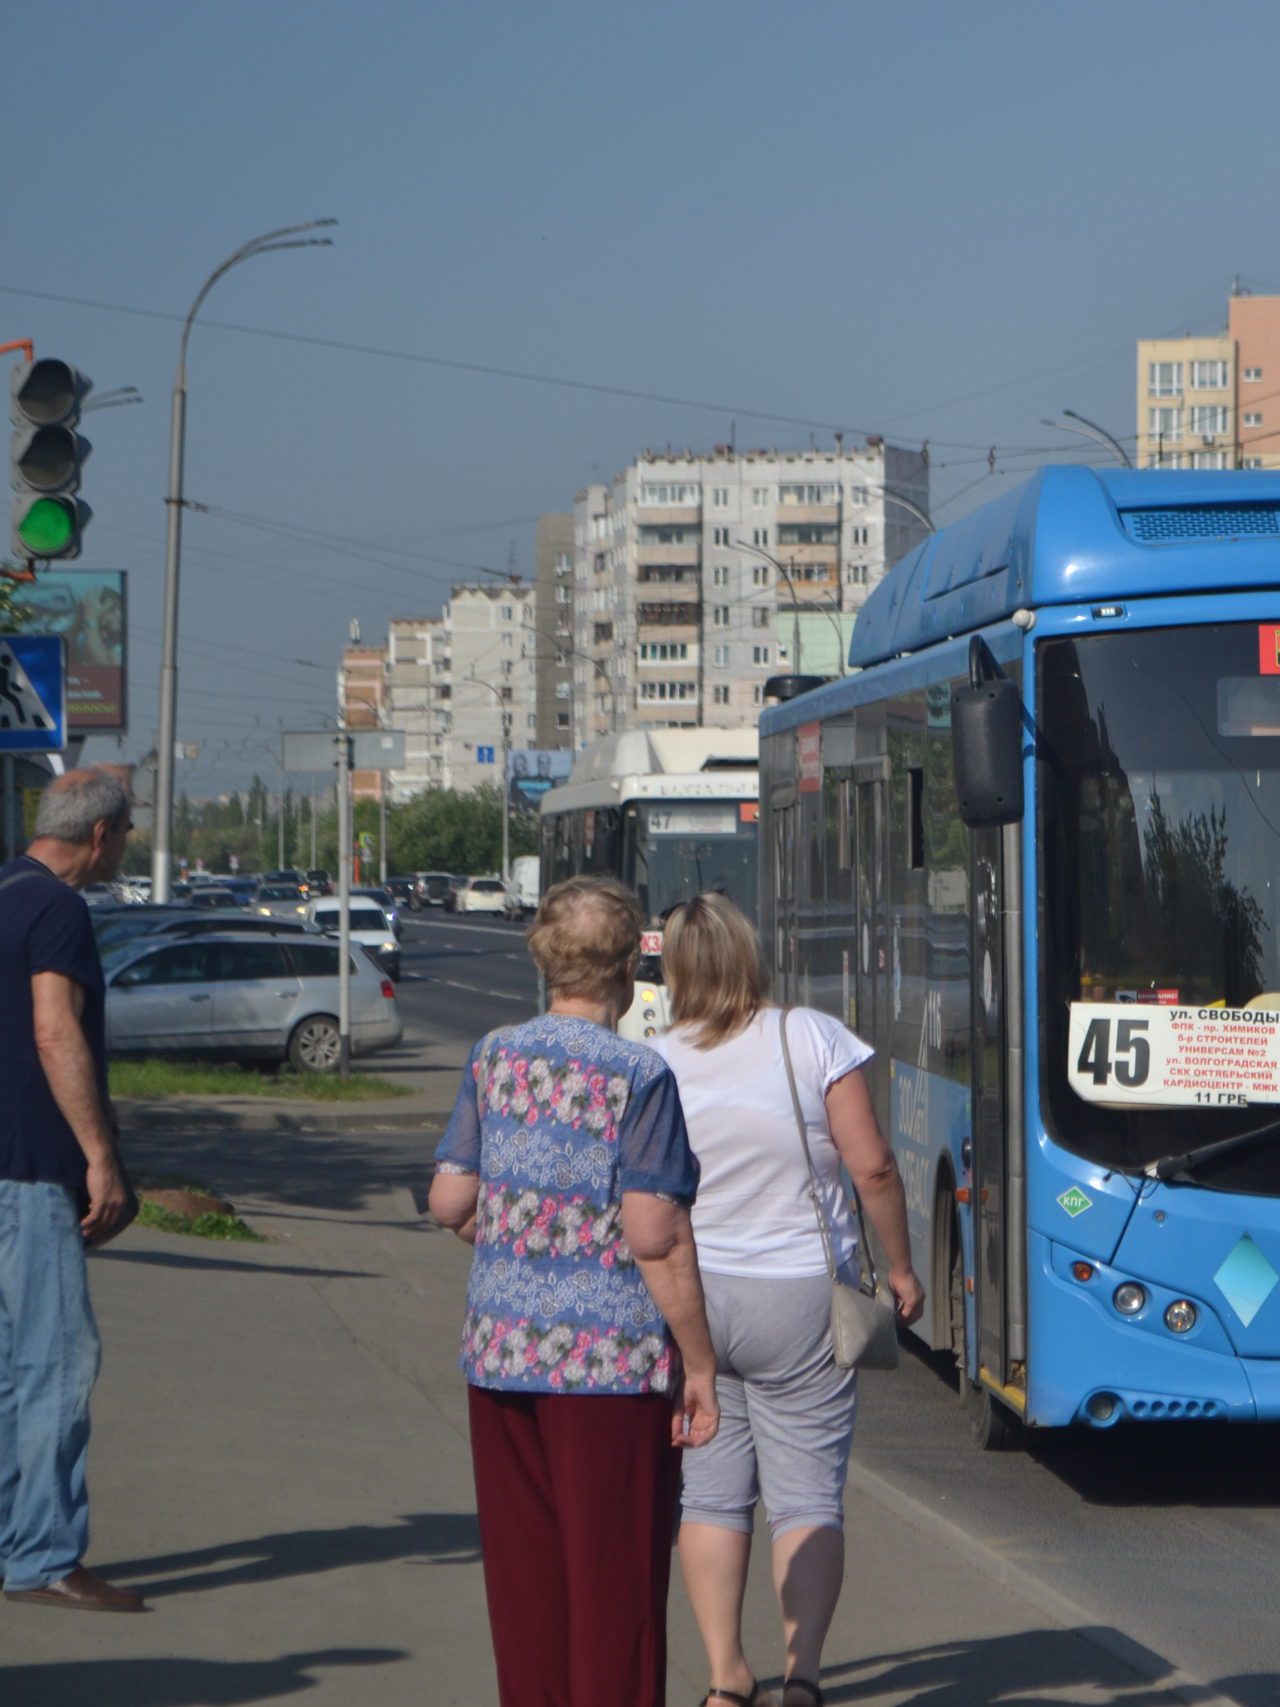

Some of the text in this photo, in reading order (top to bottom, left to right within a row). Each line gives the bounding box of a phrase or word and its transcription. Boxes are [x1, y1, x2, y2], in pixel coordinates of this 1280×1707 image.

[650, 811, 672, 830] 47
[928, 990, 942, 1050] 116
[1169, 1009, 1279, 1024] ул. СВОБОДЫ
[1171, 1022, 1194, 1031] ФПК
[1203, 1025, 1219, 1033] пр.
[1223, 1024, 1276, 1034] ХИМИКОВ
[1177, 1034, 1268, 1046] б-р СТРОИТЕЛЕЙ
[1077, 1018, 1151, 1088] 45
[1178, 1045, 1266, 1057] УНИВЕРСАМ №2
[1166, 1057, 1278, 1069] ул. ВОЛГОГРАДСКАЯ
[1170, 1068, 1273, 1080] СКК ОКТЯБРЬСКИЙ
[1163, 1079, 1243, 1090] КАРДИОЦЕНТР
[1252, 1083, 1279, 1092] МЖК
[1194, 1092, 1211, 1103] 11
[1063, 1196, 1085, 1208] КПГ
